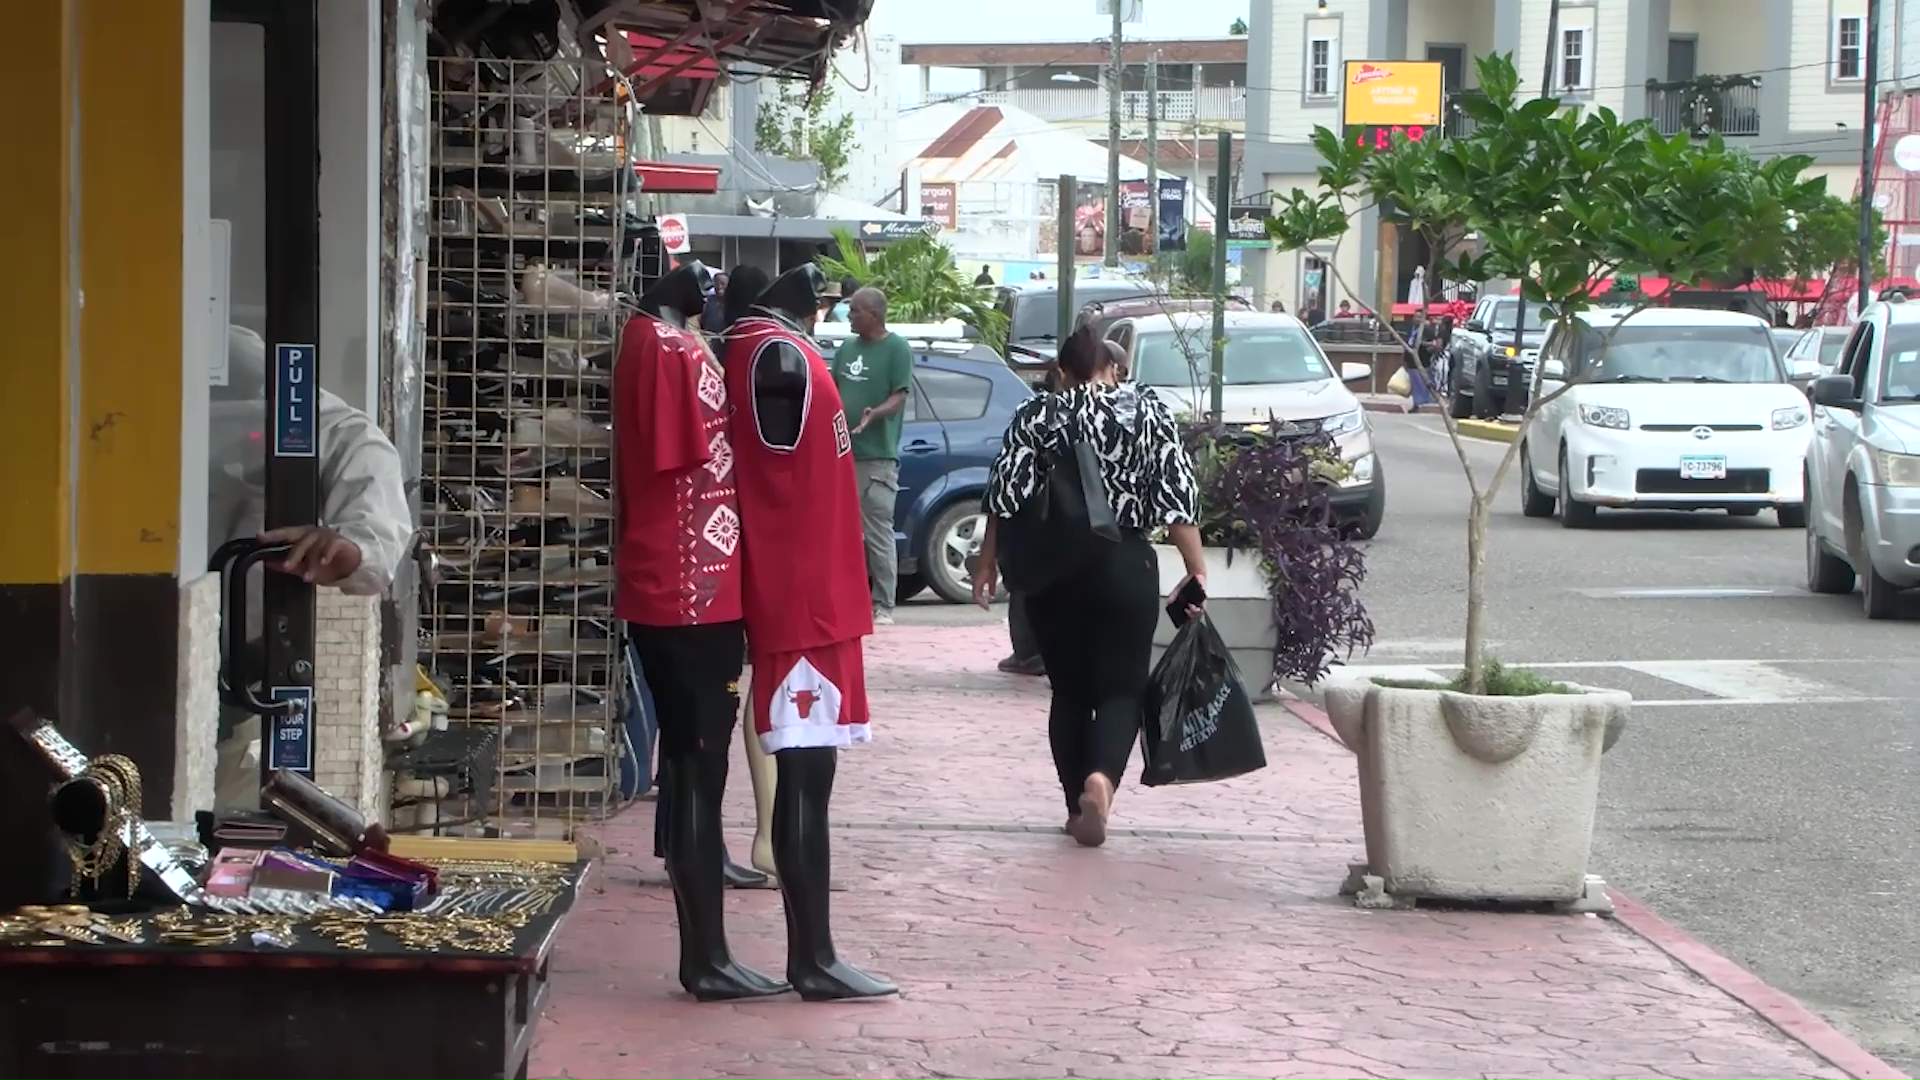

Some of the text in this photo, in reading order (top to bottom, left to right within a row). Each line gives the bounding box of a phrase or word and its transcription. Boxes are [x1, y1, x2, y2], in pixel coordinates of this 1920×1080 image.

[922, 187, 952, 198] argain
[288, 349, 303, 422] PULL
[280, 728, 303, 741] STEP
